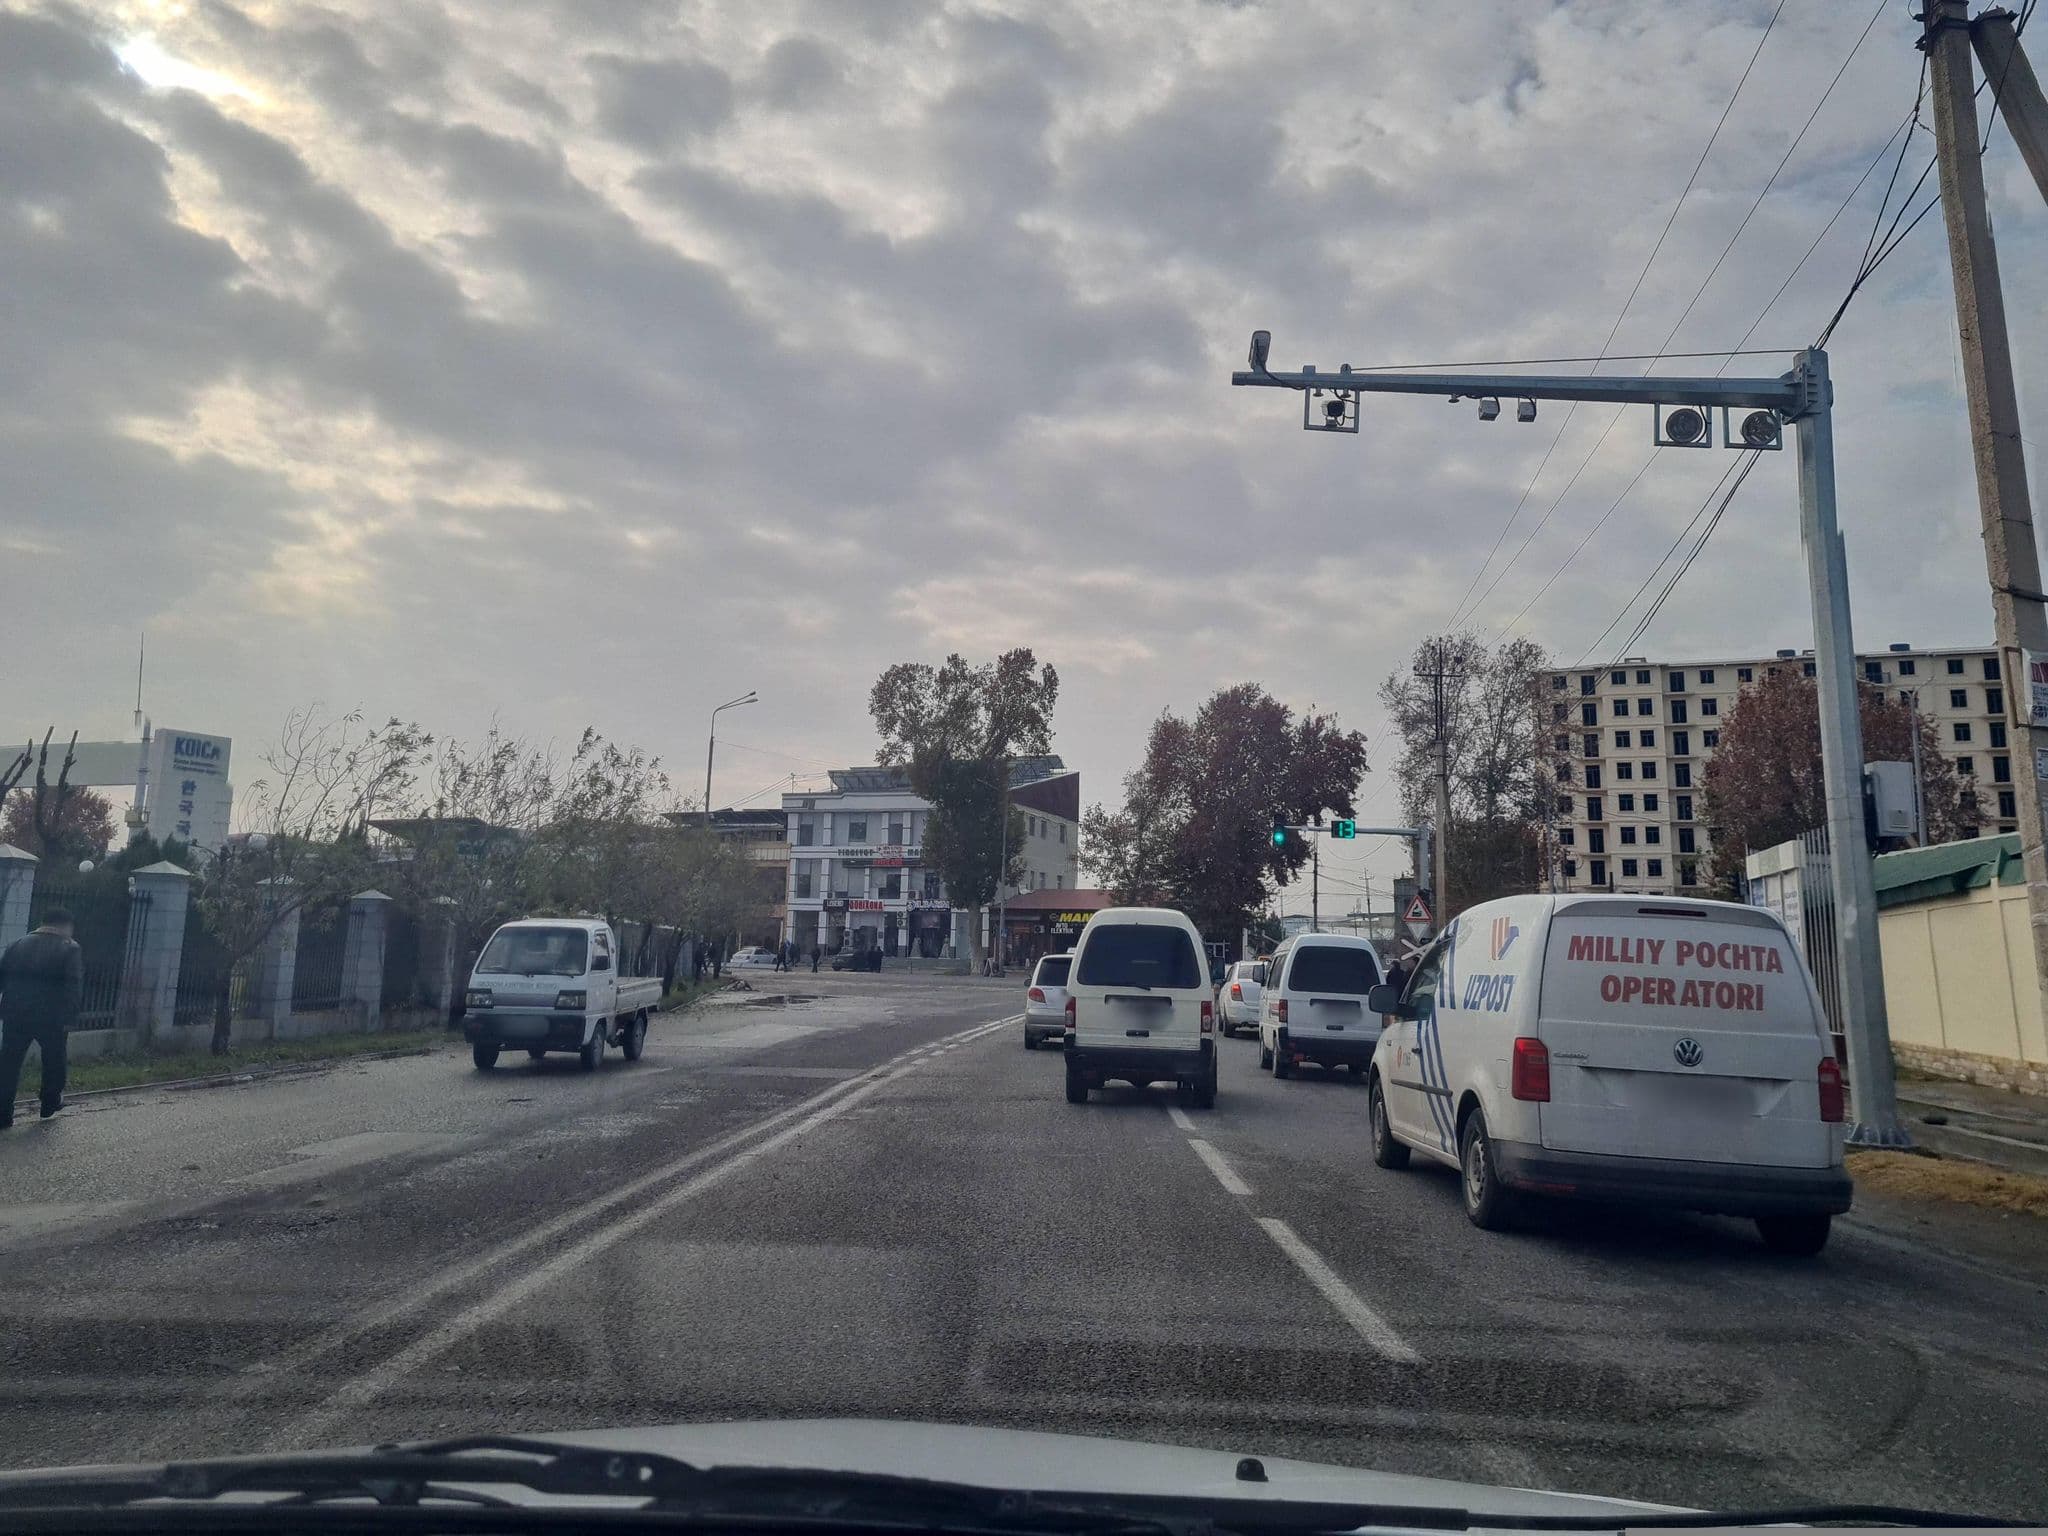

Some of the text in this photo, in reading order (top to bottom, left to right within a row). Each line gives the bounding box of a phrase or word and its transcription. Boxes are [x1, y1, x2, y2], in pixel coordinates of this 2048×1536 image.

[1338, 820, 1355, 839] 13
[1567, 935, 1784, 974] MILLIY POCHTA
[1463, 974, 1516, 1012] UZPOST
[1601, 974, 1765, 1011] OPERATORI
